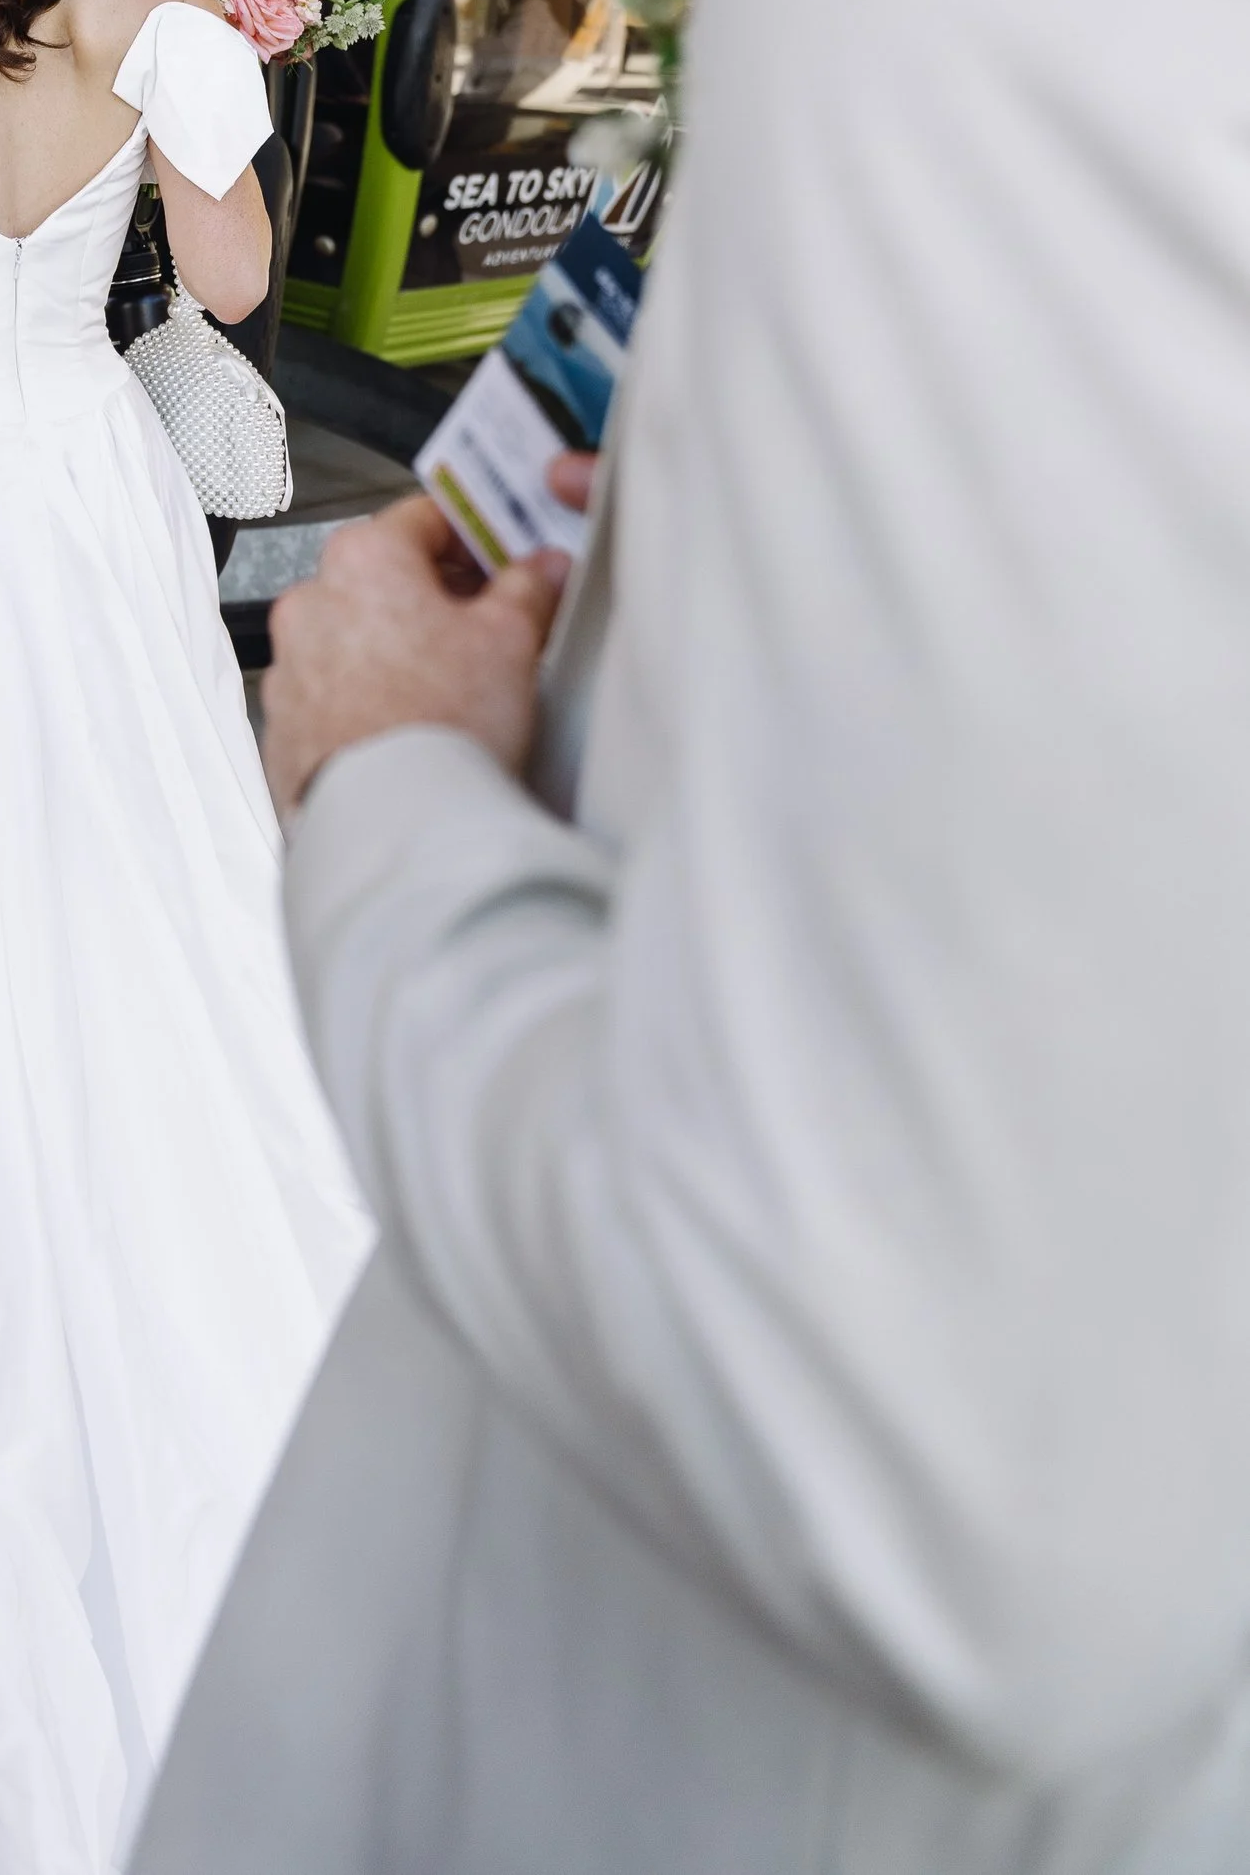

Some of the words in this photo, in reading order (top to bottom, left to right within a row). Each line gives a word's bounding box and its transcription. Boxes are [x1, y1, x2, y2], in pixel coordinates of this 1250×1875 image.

[444, 172, 499, 211] SEA
[506, 168, 544, 205] TO
[544, 166, 596, 201] SKY
[458, 203, 581, 246] GONDOLA
